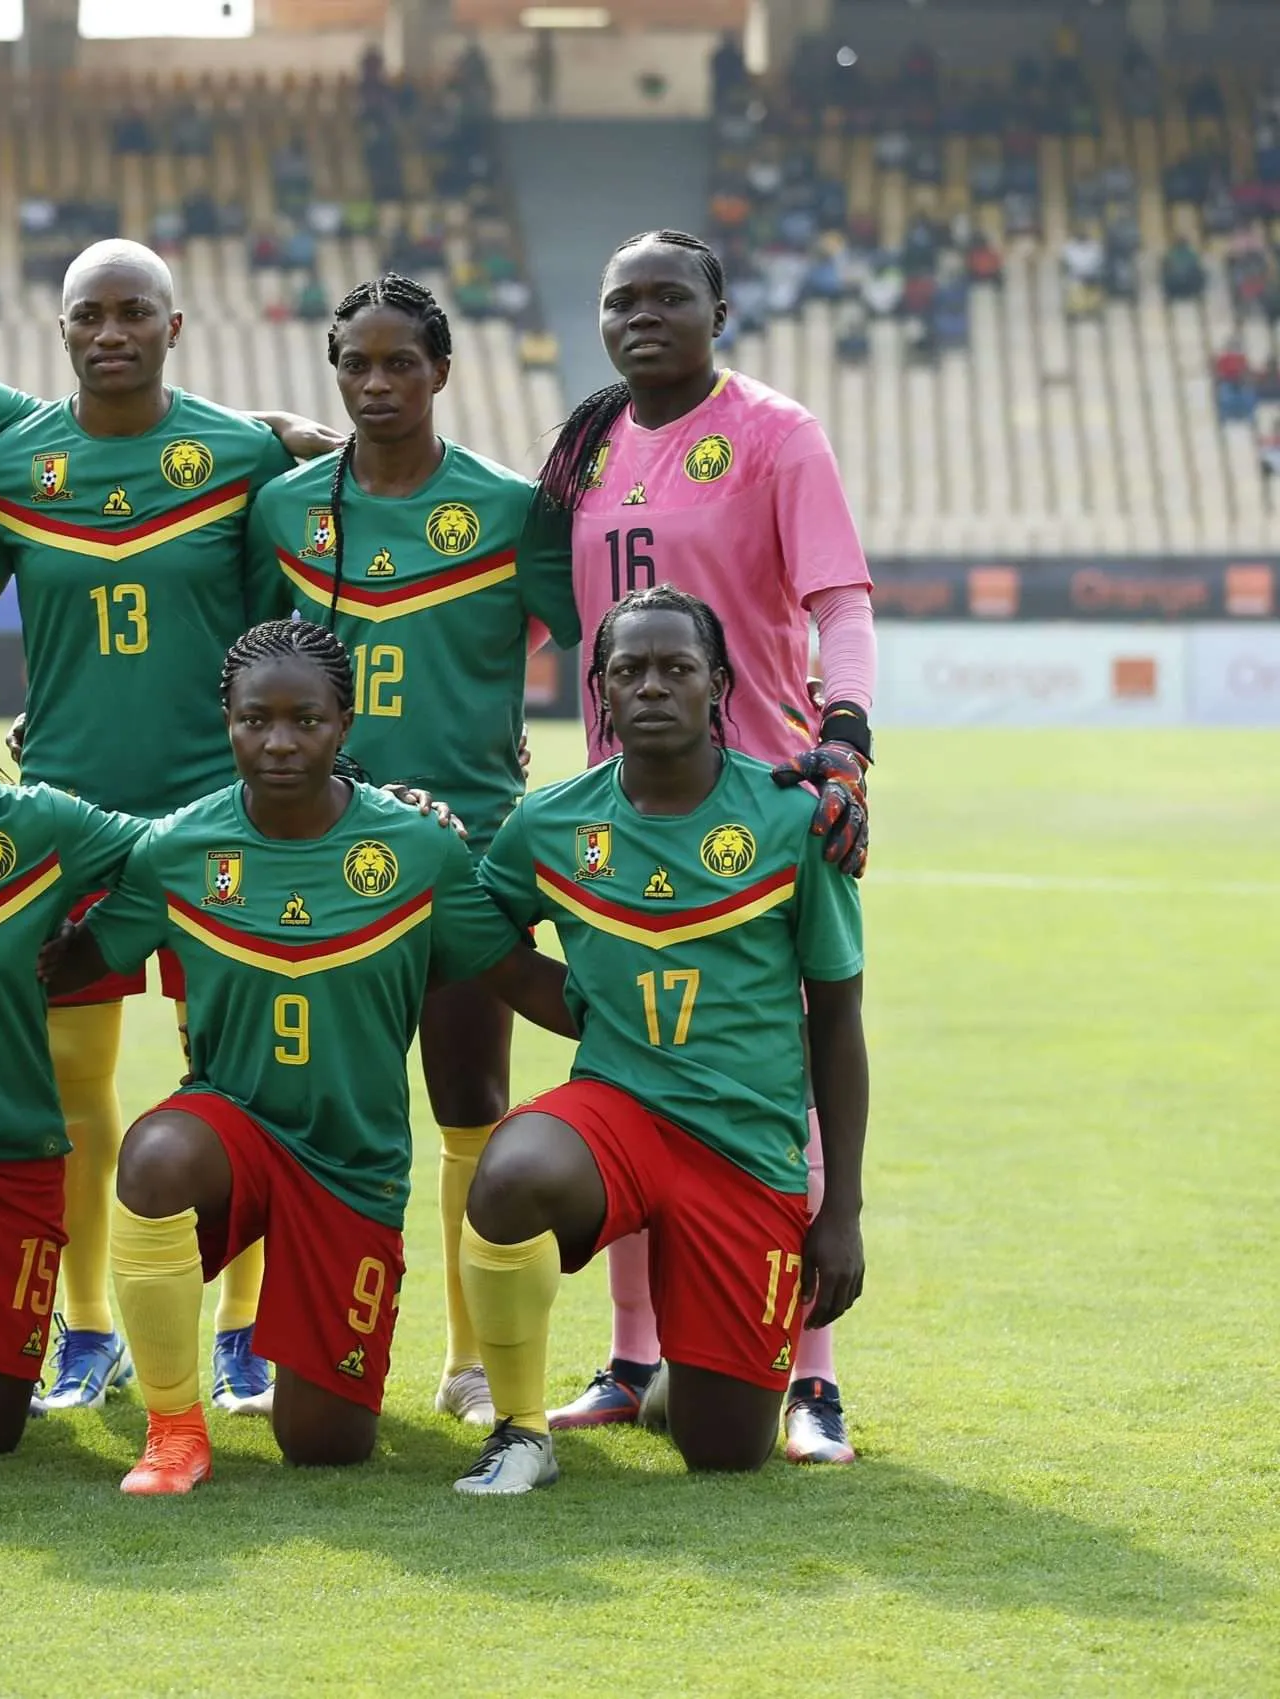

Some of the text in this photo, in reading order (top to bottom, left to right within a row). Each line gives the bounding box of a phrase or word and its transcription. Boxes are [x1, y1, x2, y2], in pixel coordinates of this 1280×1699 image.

[605, 527, 656, 602] 16
[90, 584, 149, 656] 13
[354, 645, 404, 717] 12
[274, 994, 310, 1065] 9
[637, 969, 700, 1046] 17
[12, 1238, 57, 1315] 15
[348, 1256, 386, 1334] 9
[761, 1249, 802, 1330] 17
